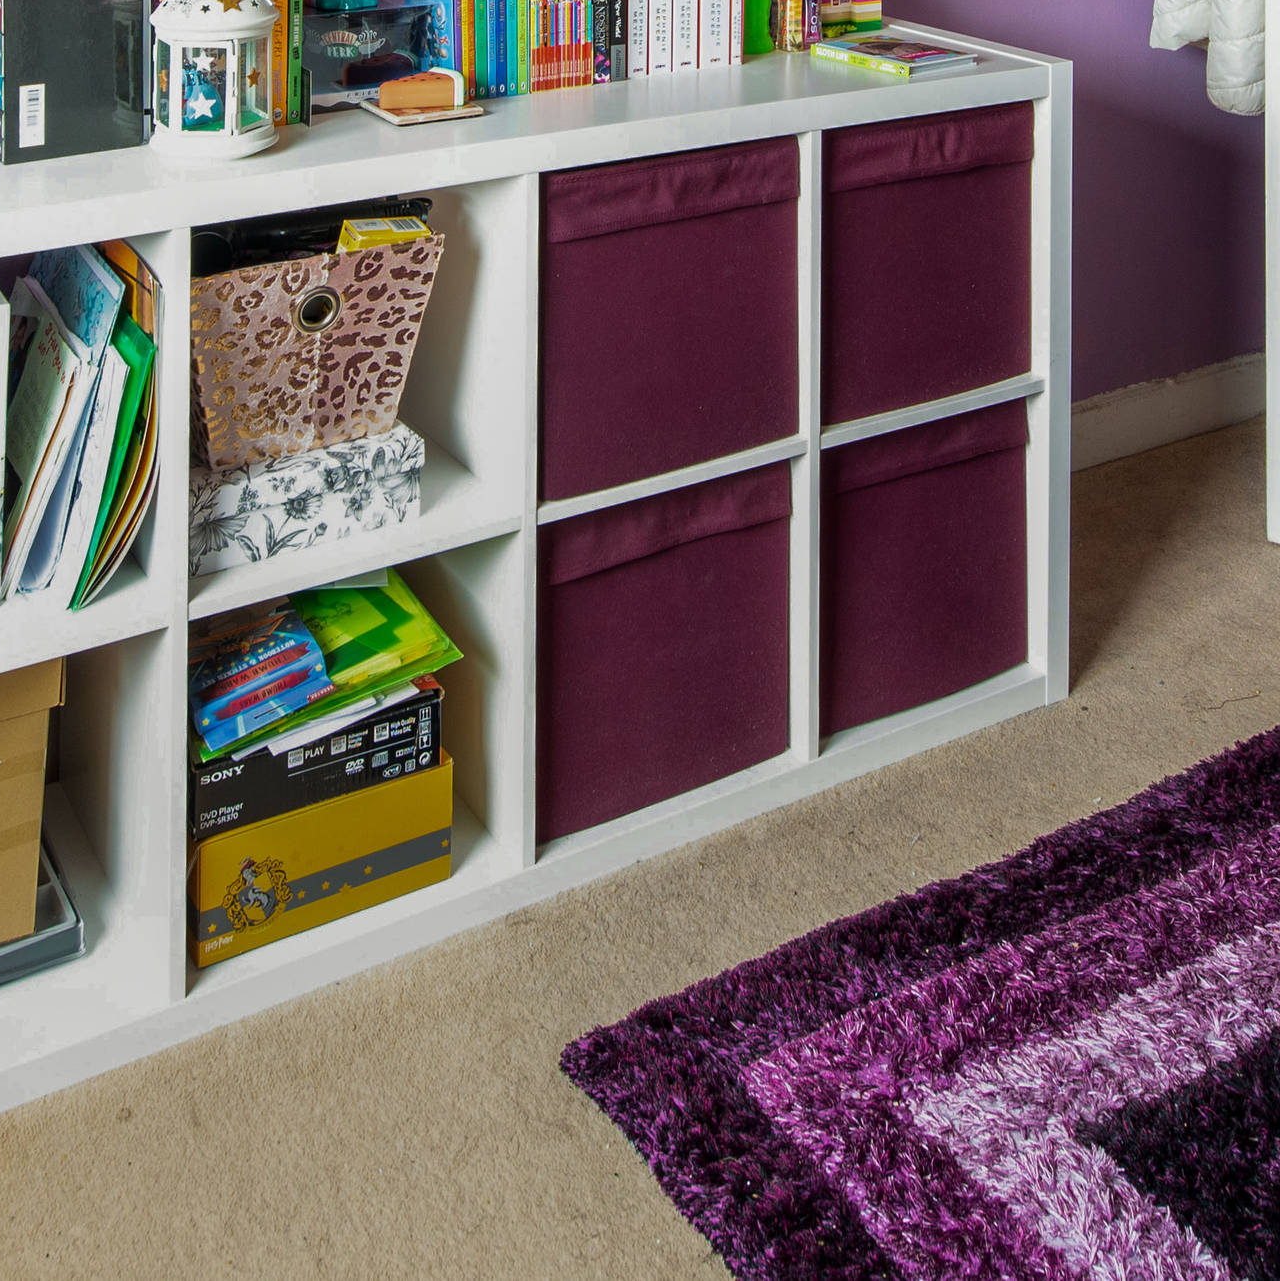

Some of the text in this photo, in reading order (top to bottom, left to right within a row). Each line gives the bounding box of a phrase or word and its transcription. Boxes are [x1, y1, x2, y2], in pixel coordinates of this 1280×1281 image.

[595, 6, 606, 50] JACKSON
[321, 30, 358, 46] CENTRAL
[327, 46, 356, 58] PERK
[305, 745, 325, 759] PLAY
[200, 764, 245, 785] SONY
[200, 802, 244, 822] DVD Player
[200, 812, 239, 829] DVP-SR370
